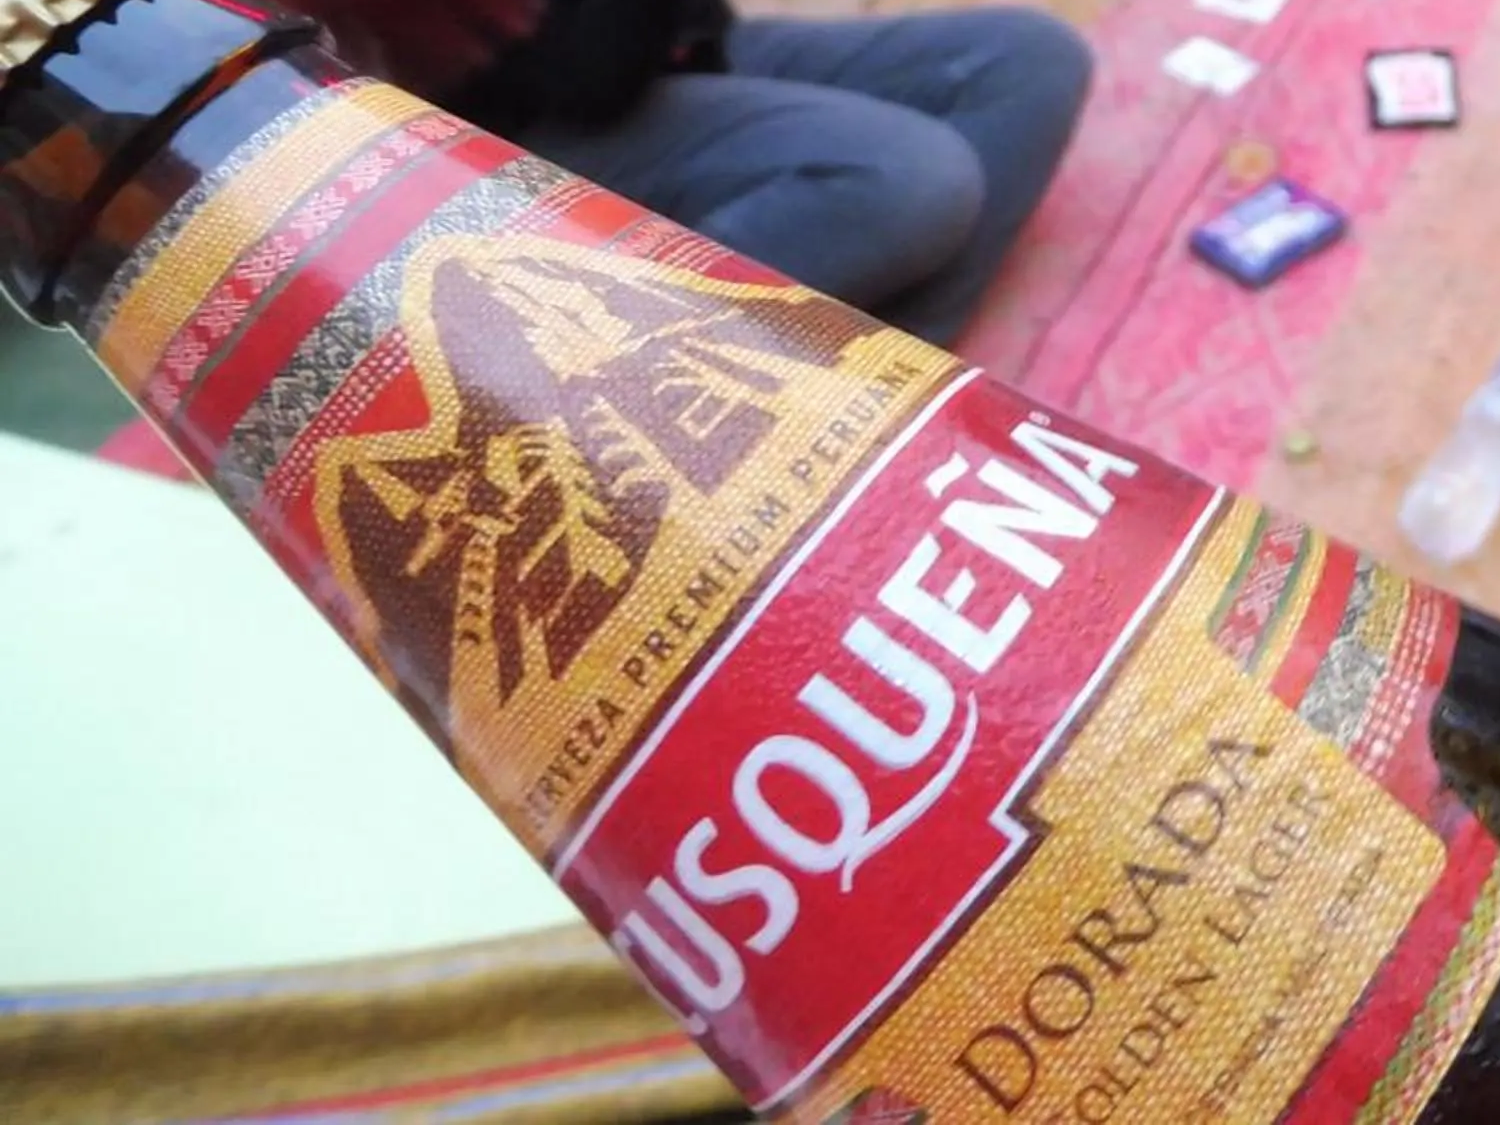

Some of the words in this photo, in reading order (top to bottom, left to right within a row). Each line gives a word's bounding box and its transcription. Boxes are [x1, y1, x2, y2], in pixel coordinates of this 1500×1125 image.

[621, 494, 790, 689] PREMIUM
[954, 739, 1272, 1114] DORADA
[1036, 969, 1217, 1125] OLDEN
[1203, 784, 1330, 946] LAGER
